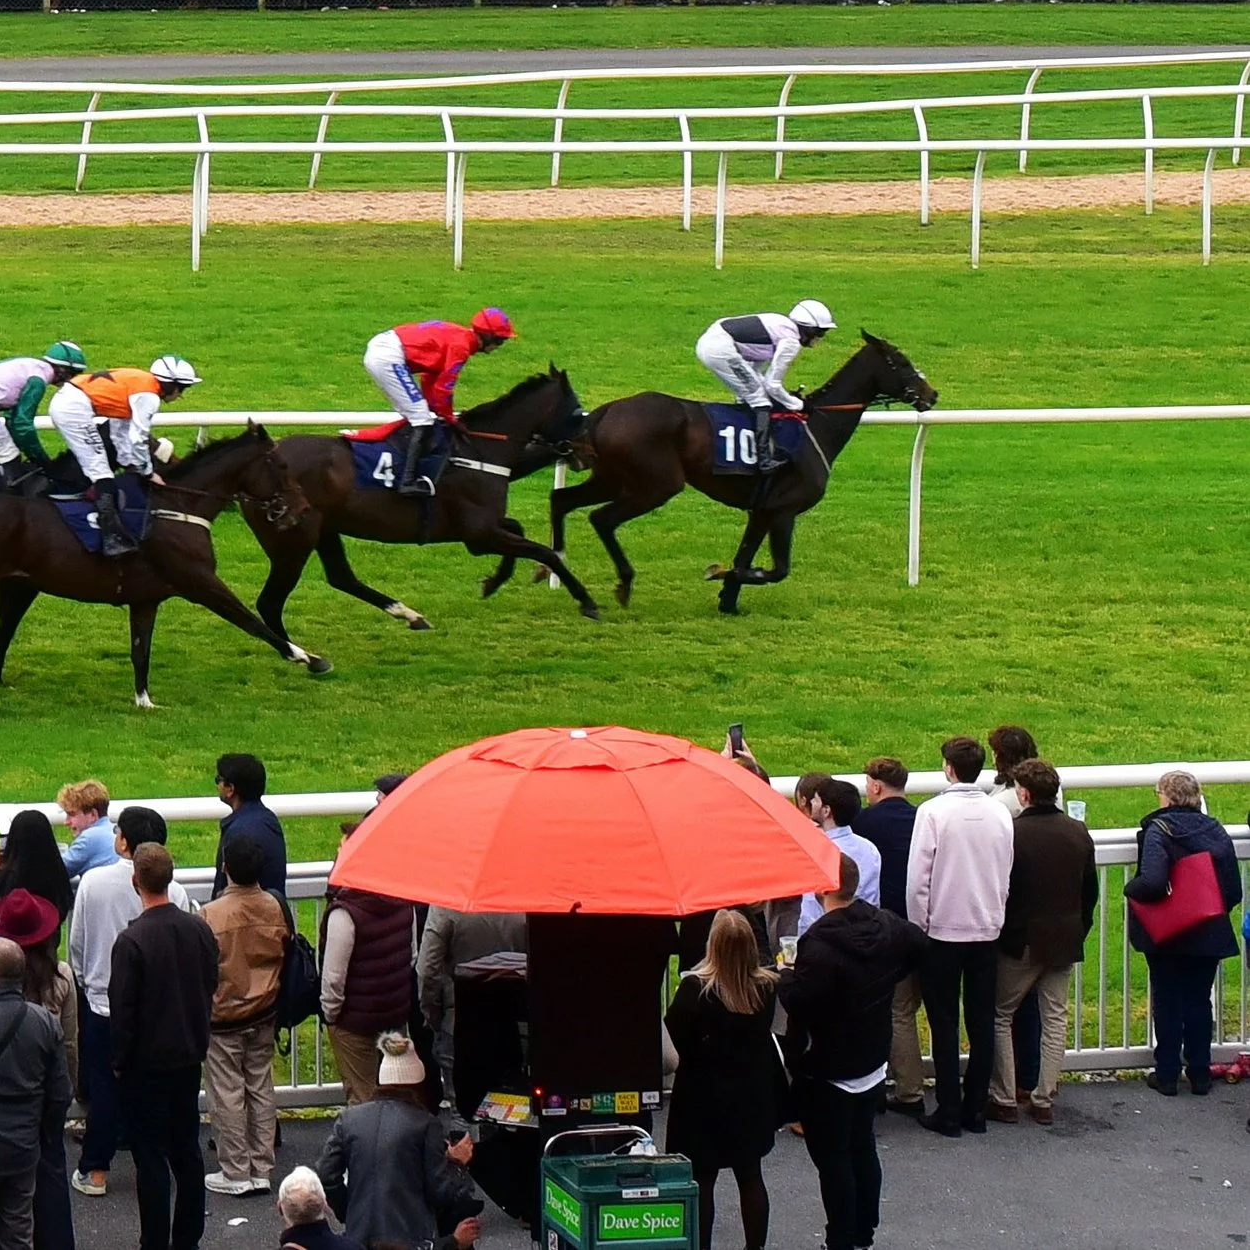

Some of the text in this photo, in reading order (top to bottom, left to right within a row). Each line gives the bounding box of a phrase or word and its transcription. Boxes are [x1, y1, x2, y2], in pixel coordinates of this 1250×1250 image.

[719, 425, 758, 464] 10
[373, 452, 395, 488] 4
[546, 1186, 561, 1214] Dave
[603, 1212, 680, 1234] Dave Spice
